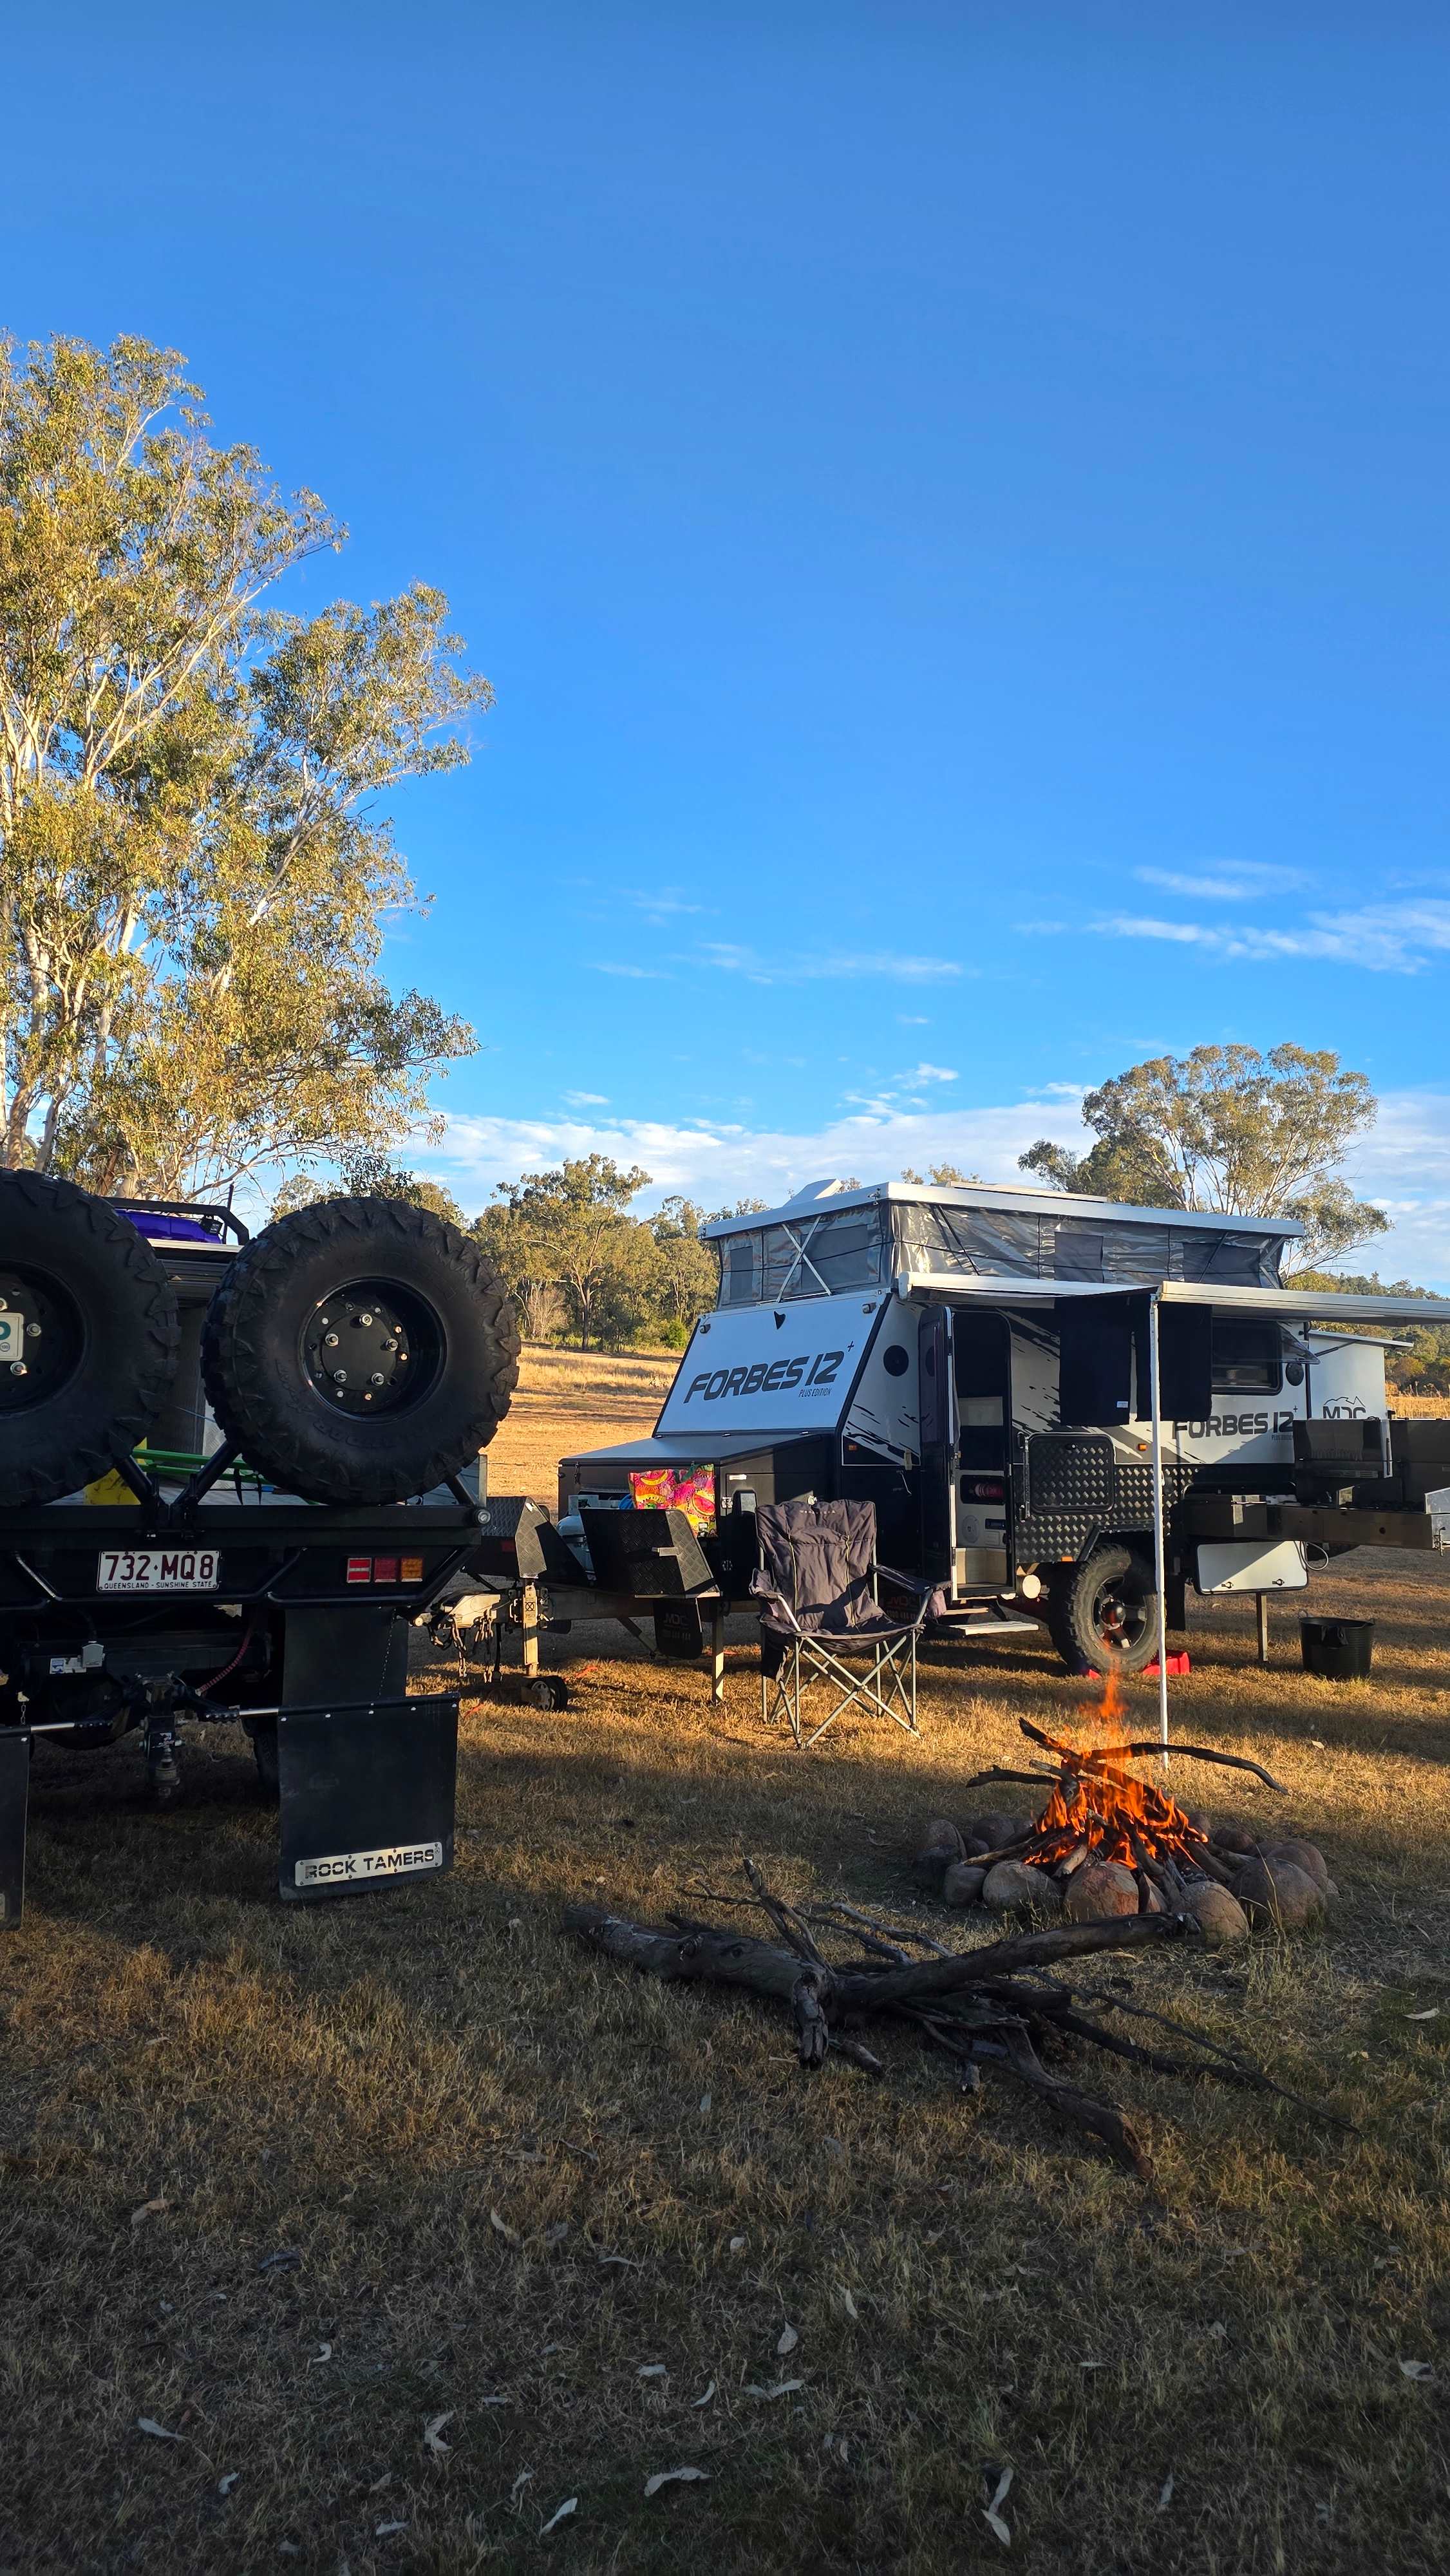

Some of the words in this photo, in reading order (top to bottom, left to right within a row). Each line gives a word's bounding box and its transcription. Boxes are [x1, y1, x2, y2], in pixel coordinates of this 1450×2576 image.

[683, 1356, 811, 1404] FORBES
[798, 1388, 812, 1397] PLUS
[811, 1388, 831, 1397] EDITION
[1172, 1412, 1268, 1439] FORBES
[106, 1555, 151, 1581] 732
[160, 1554, 214, 1580] MQ8
[305, 1860, 357, 1879] ROCK
[363, 1849, 434, 1871] TAMERS
